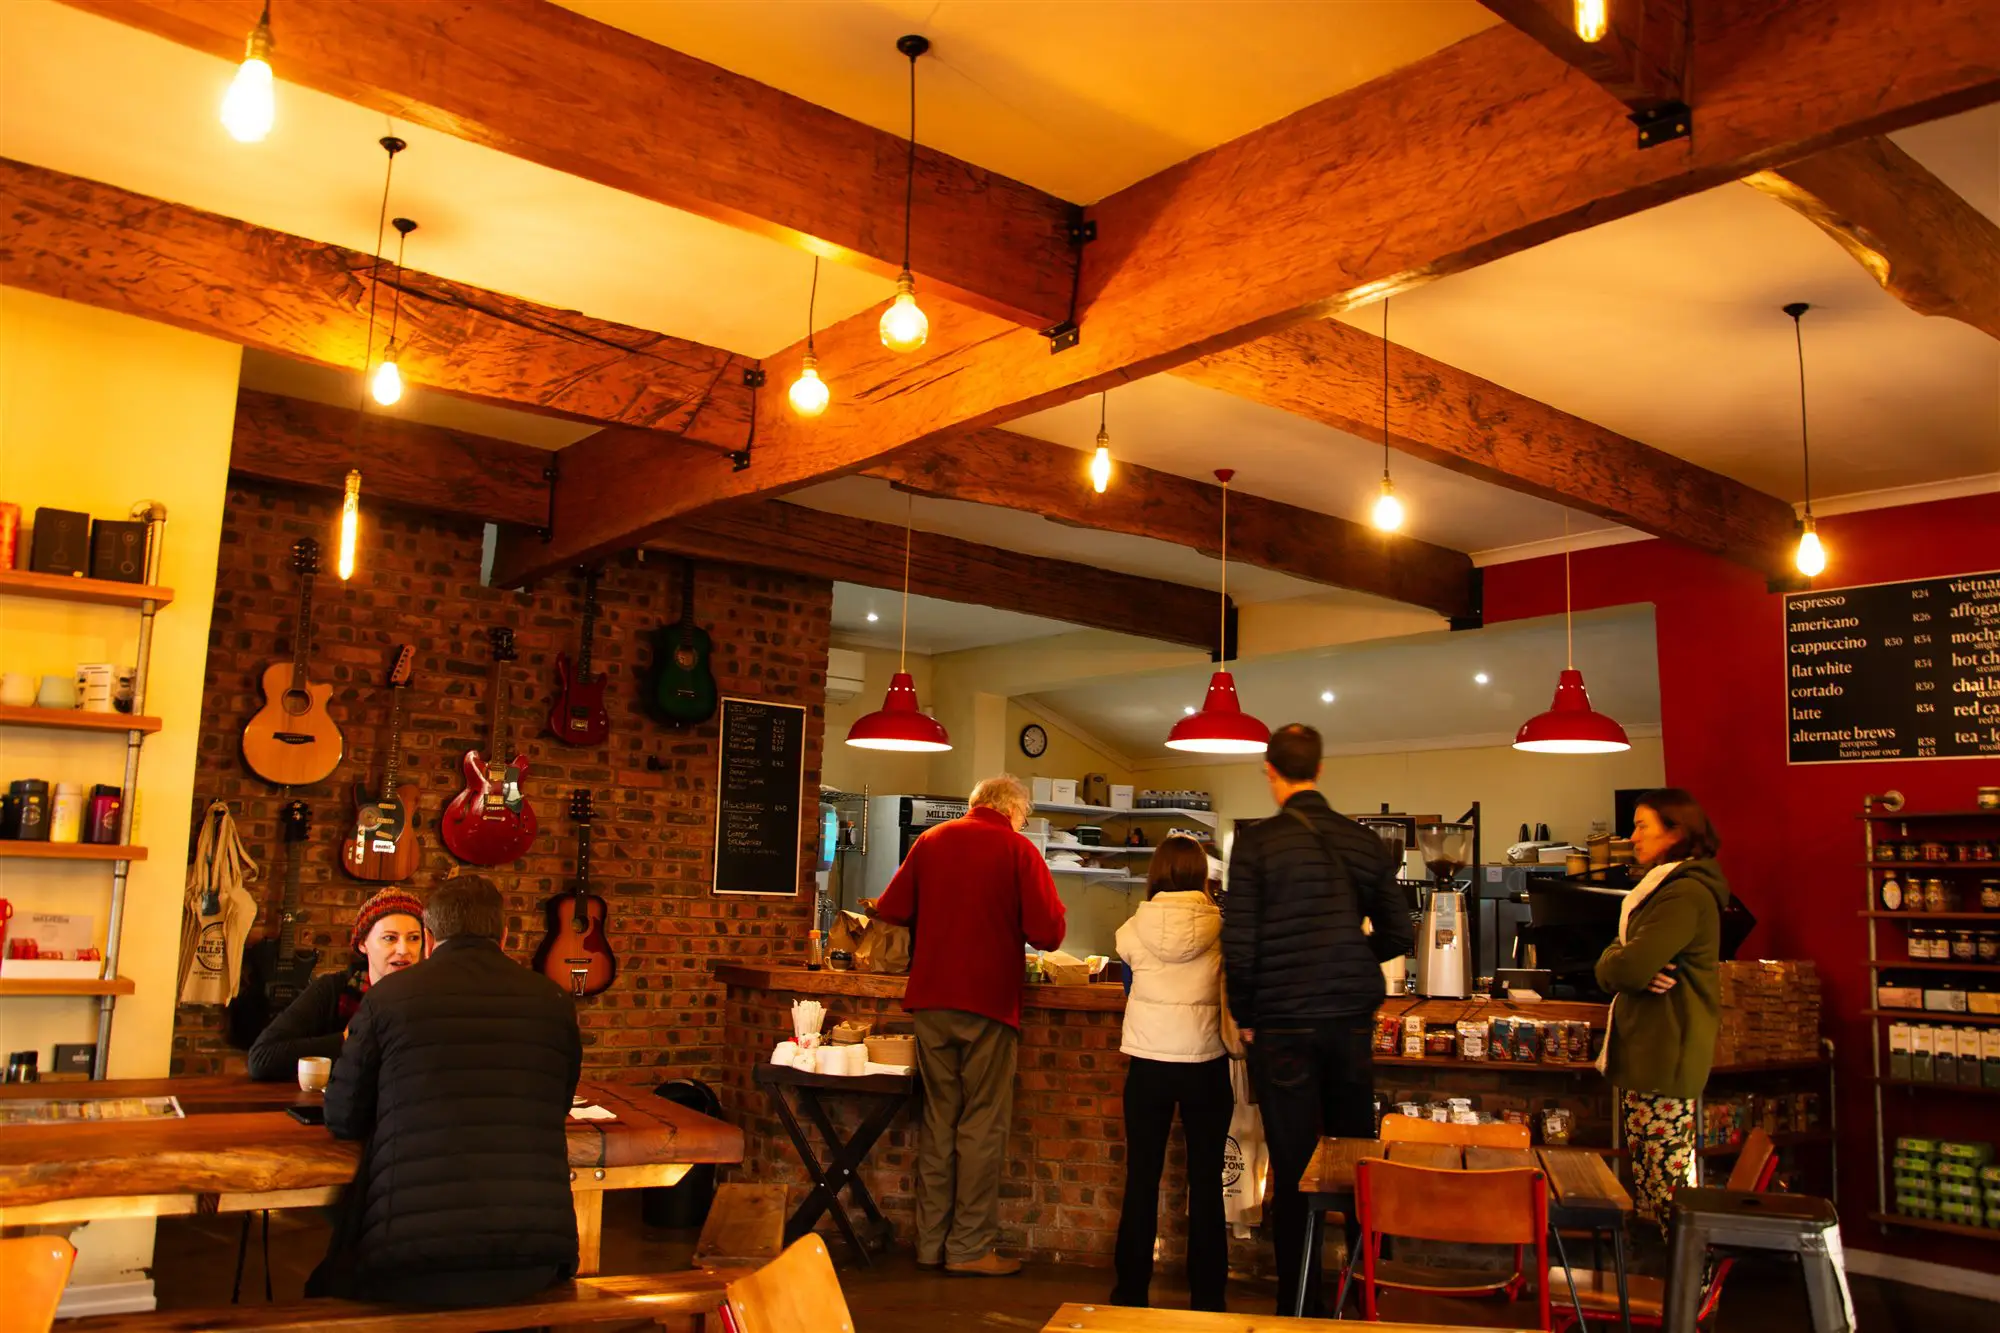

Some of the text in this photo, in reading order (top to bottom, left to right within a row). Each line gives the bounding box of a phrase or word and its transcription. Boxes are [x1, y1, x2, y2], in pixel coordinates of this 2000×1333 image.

[1789, 595, 1846, 612] espresso
[1789, 616, 1860, 632] americano
[1790, 636, 1868, 655] cappuccino
[1952, 650, 2000, 668] hot ch
[1792, 664, 1813, 677] flat
[1815, 661, 1853, 675] white
[1791, 682, 1844, 698] cortado
[1952, 676, 1985, 692] chai
[1792, 707, 1822, 720] latte
[1953, 700, 2000, 717] red ca
[1978, 714, 1994, 725] red
[1792, 726, 1896, 743] alternate brews
[1954, 731, 1979, 744] tea
[1839, 739, 1878, 749] aeropress
[1839, 749, 1861, 757] hario
[1862, 749, 1882, 758] pour
